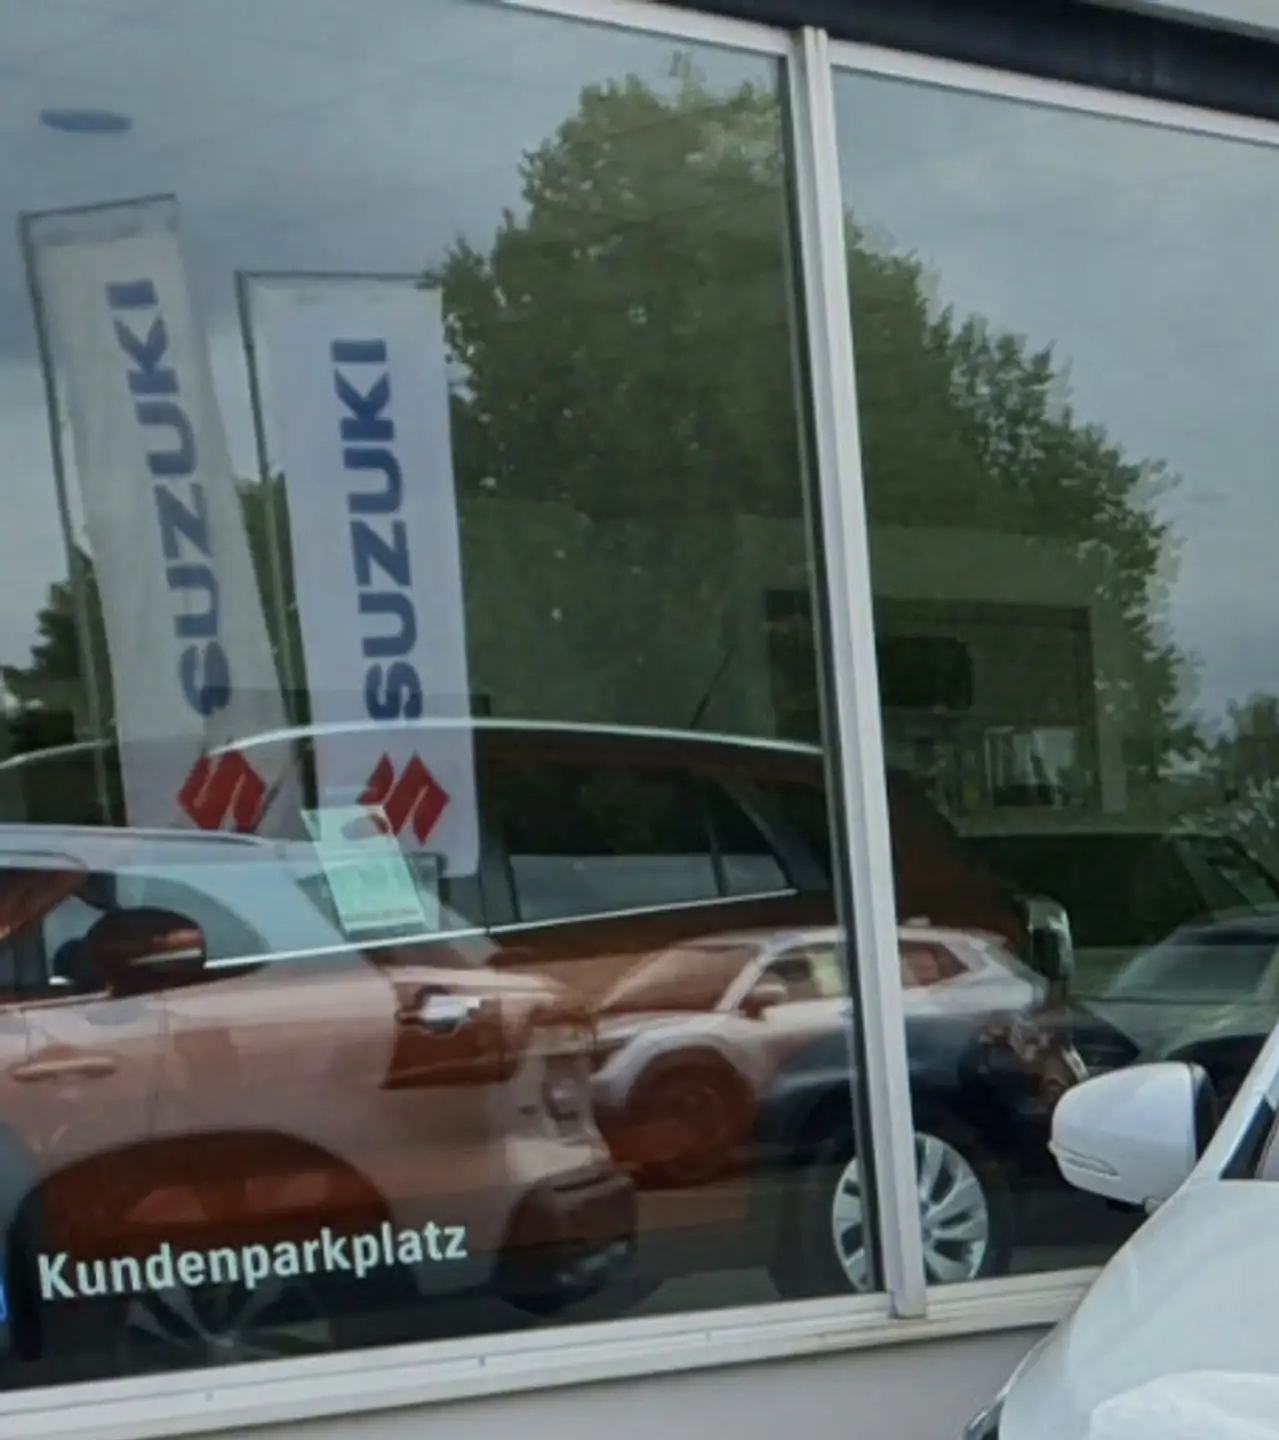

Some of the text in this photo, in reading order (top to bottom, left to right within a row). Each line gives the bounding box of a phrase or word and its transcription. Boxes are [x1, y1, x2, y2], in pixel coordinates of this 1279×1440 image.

[105, 278, 232, 717] SUZUKI
[330, 338, 423, 722] SUZUKI
[37, 1221, 468, 1300] Kundenparkplatz
